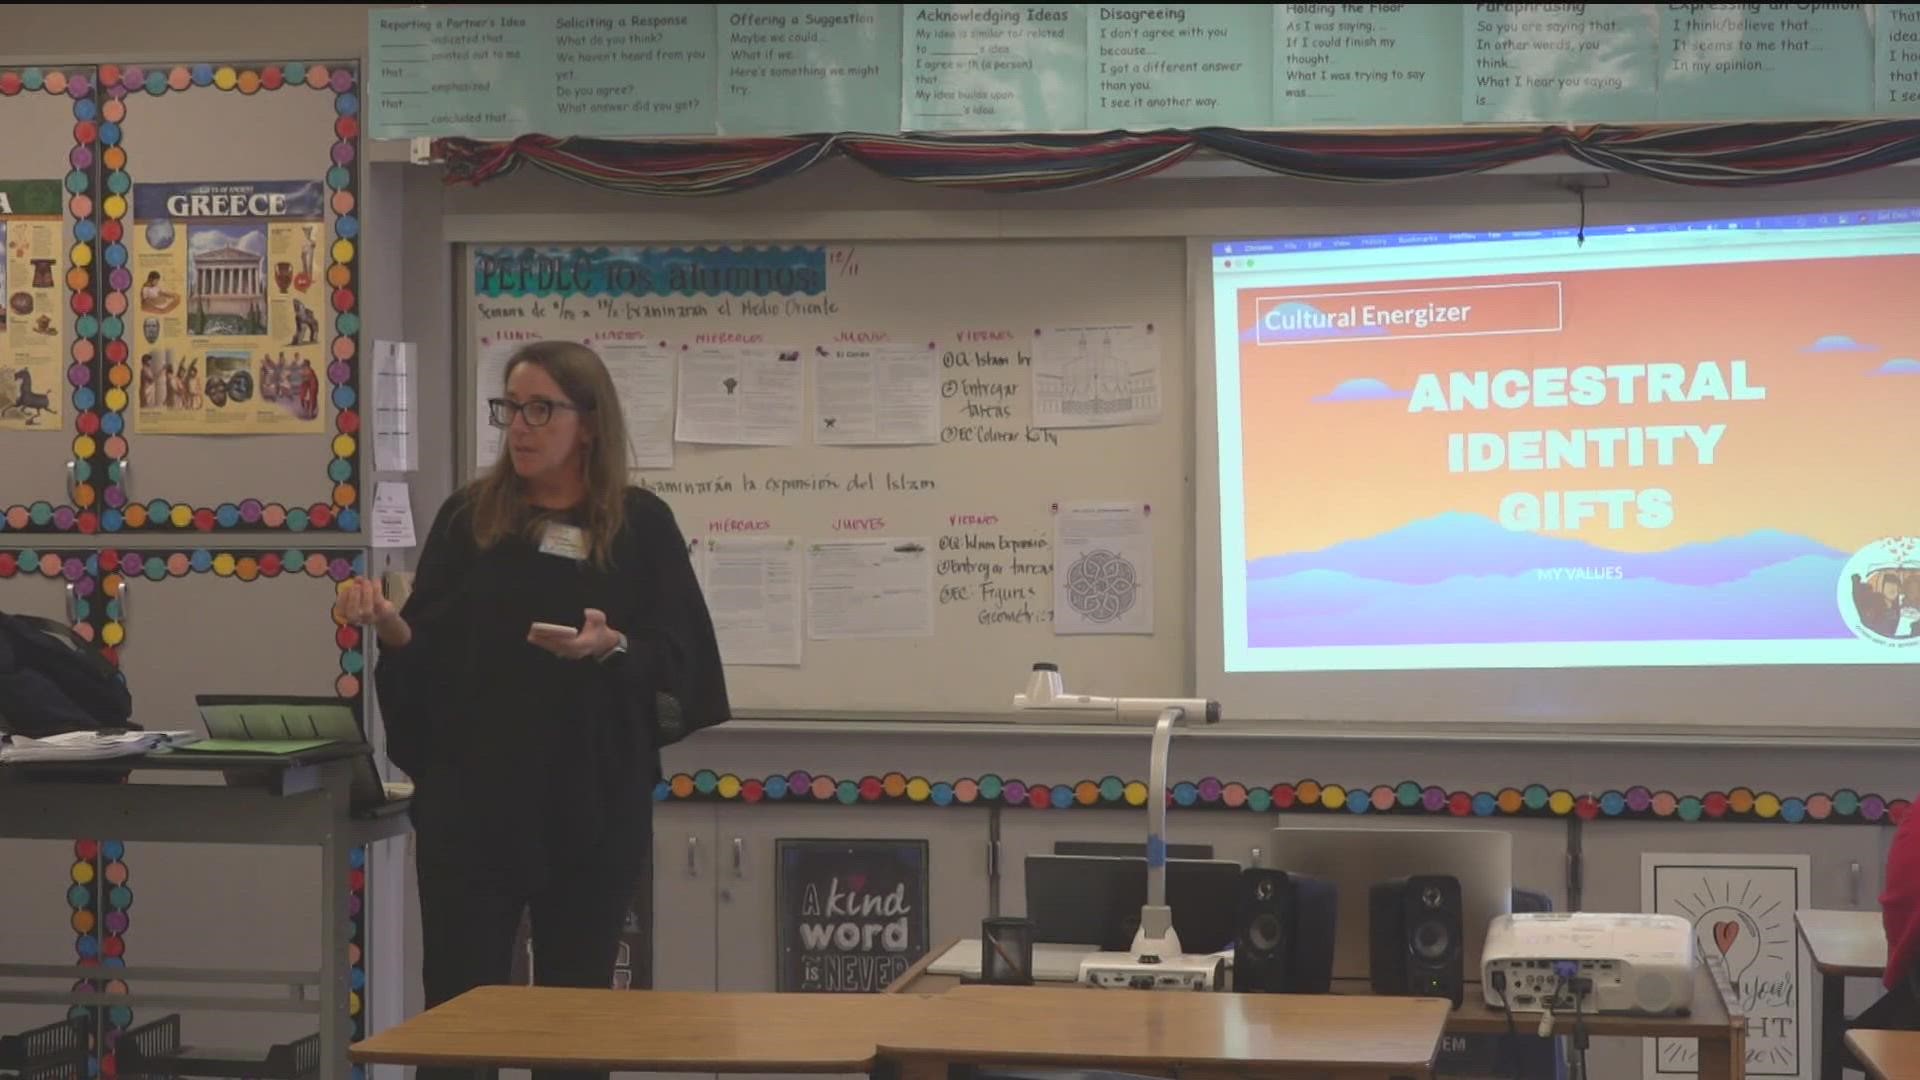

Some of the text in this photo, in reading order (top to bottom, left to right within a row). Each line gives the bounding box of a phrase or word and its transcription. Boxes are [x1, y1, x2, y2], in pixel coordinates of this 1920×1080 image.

[916, 9, 1068, 25] Acknowledging Ideas
[1100, 8, 1185, 24] Disagreeing
[1286, 4, 1404, 17] Holding the Floor
[380, 17, 526, 31] Reporting Partner's Idea
[556, 15, 688, 31] Soliciting Response
[729, 13, 874, 28] Offering Suggestion
[1286, 22, 1300, 31] As
[1314, 22, 1334, 31] was
[1477, 21, 1493, 32] So
[1496, 23, 1517, 34] you
[1546, 21, 1585, 34] saying
[1686, 19, 1775, 31] think/believe
[557, 33, 663, 47] What do you think?
[730, 32, 785, 44] Maybe we
[916, 30, 931, 40] My
[934, 29, 955, 39] idea
[1110, 27, 1227, 41] don't agree with you
[1286, 36, 1396, 48] If could finish my
[1477, 39, 1491, 50] In
[1495, 40, 1528, 50] other
[1578, 41, 1600, 51] you
[1673, 39, 1775, 50] It seems to me
[557, 50, 706, 63] We haven't heard from you
[731, 50, 774, 60] What if
[770, 67, 826, 79] something
[830, 67, 844, 76] we
[847, 65, 879, 79] might
[924, 60, 952, 71] agree
[994, 59, 1033, 71] person)
[1110, 60, 1243, 76] got different answer
[1673, 59, 1710, 73] In my
[1286, 70, 1426, 82] What was trying to say
[1477, 76, 1622, 90] What hear you saying
[556, 85, 634, 98] Do you agree?
[1100, 79, 1126, 90] than
[915, 91, 931, 102] My
[934, 90, 955, 99] idea
[1110, 95, 1191, 108] see it another
[558, 101, 671, 114] What answer did you
[167, 193, 287, 217] GREECE
[1264, 303, 1471, 331] Cultural Energizer
[1408, 360, 1766, 413] ANCESTRAL
[1448, 424, 1727, 473] IDENTITY
[847, 472, 873, 491] del
[1498, 488, 1673, 532] GIFTS
[1537, 565, 1623, 580] MY VALUES
[802, 876, 911, 917] A kind
[800, 917, 908, 951] word
[806, 962, 819, 981] is
